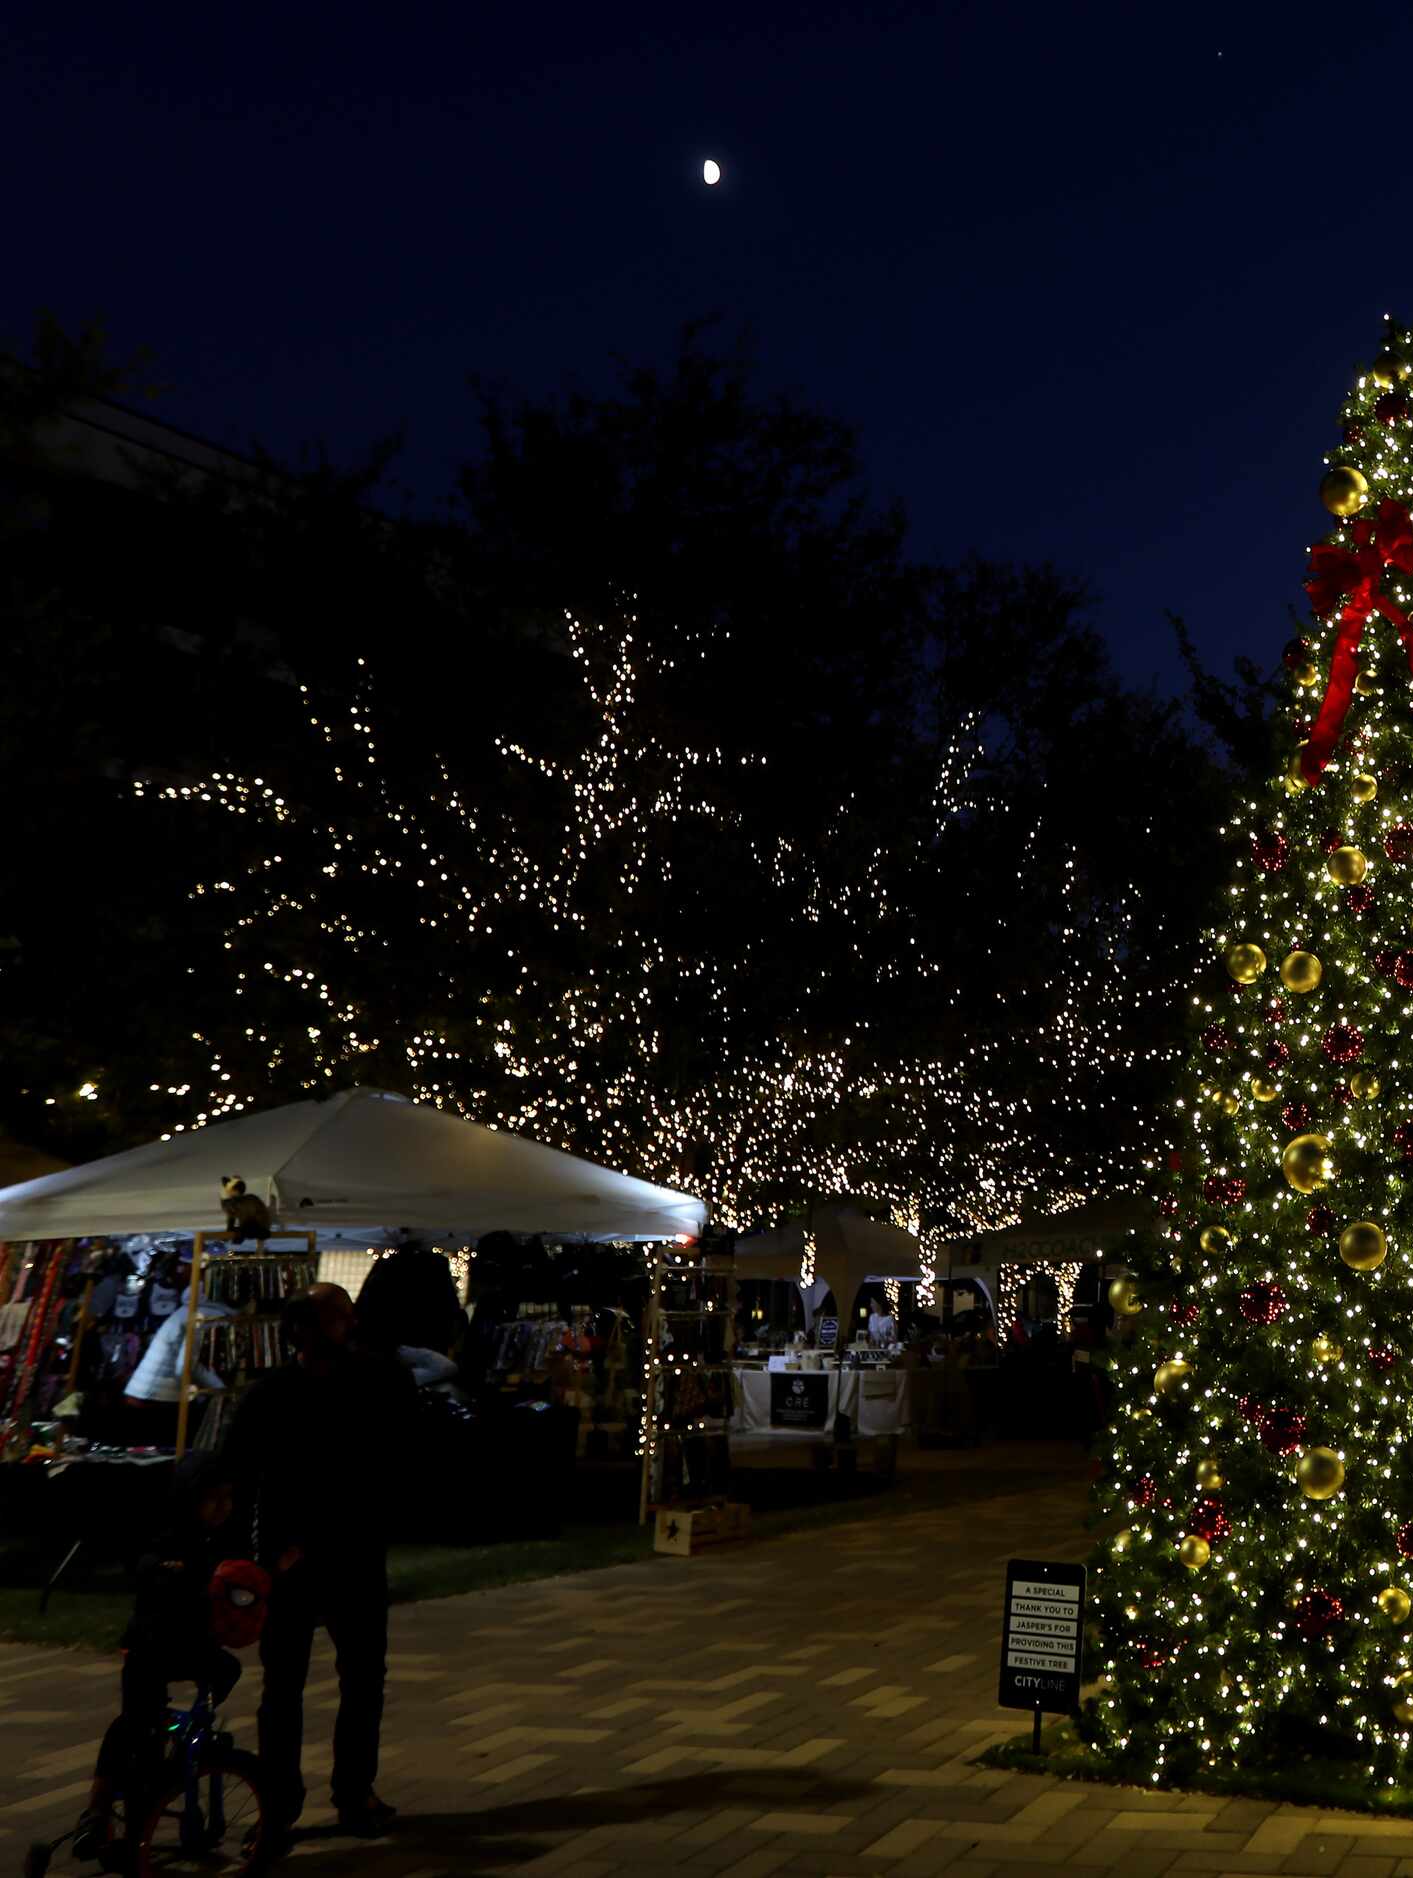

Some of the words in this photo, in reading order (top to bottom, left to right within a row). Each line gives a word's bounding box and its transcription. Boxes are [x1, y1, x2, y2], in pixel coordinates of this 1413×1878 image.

[1025, 1586, 1031, 1595] A
[1033, 1587, 1065, 1597] SPECIAL
[1015, 1603, 1042, 1613] THANK
[1044, 1606, 1061, 1615] YOU
[1063, 1607, 1074, 1616] TO
[1016, 1620, 1052, 1632] JASPER'S
[1054, 1623, 1071, 1633] FOR
[1011, 1638, 1054, 1650] PROVIDING
[1057, 1641, 1074, 1651] THIS
[1014, 1656, 1045, 1668] FESTIVE
[1048, 1660, 1068, 1670] TREE
